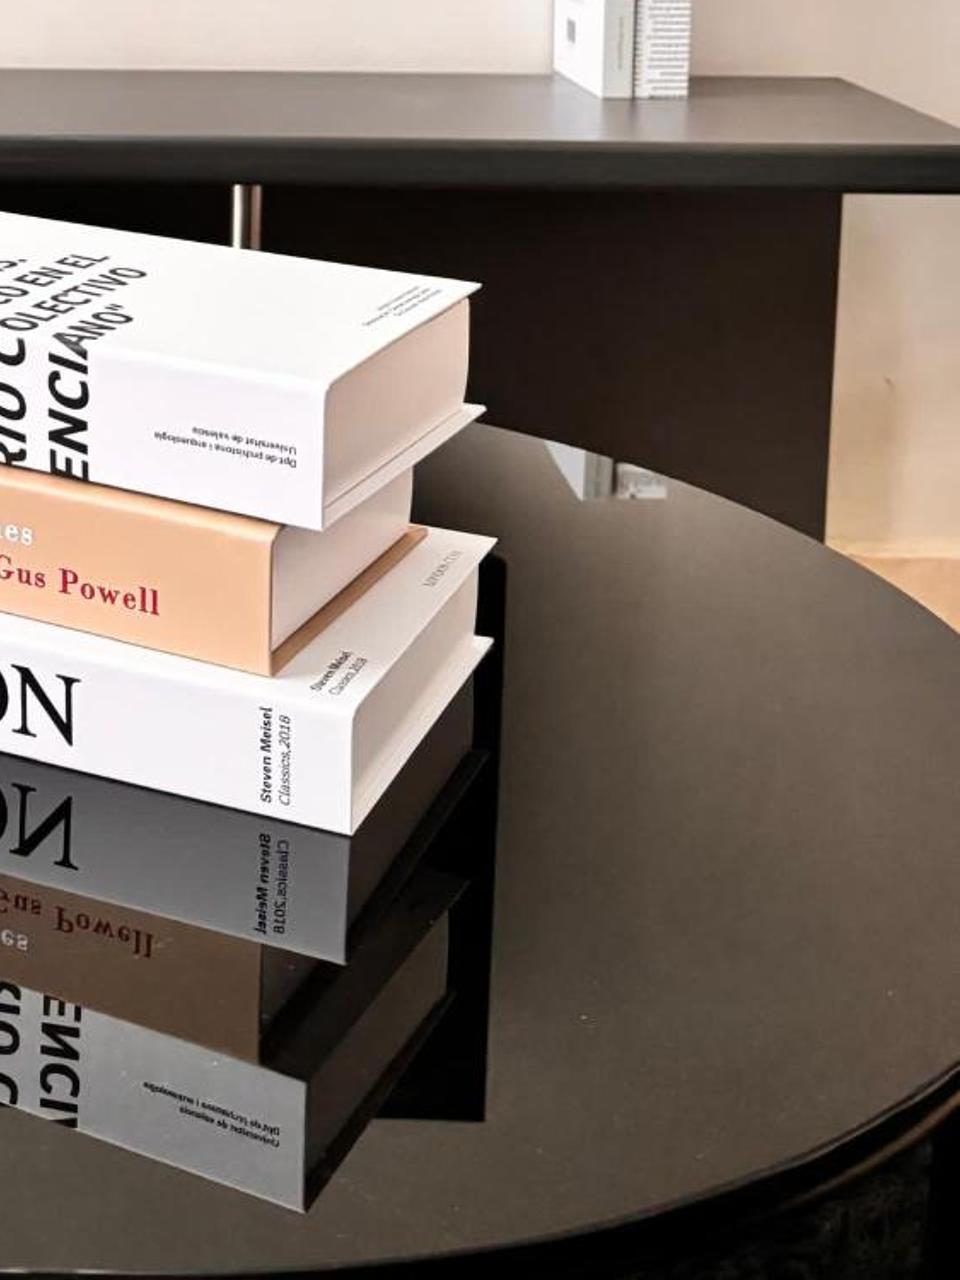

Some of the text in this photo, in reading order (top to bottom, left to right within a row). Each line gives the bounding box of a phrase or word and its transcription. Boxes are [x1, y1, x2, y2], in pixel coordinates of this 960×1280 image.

[16, 266, 67, 287] EN
[55, 253, 110, 269] EL
[58, 568, 161, 616] Powell
[259, 706, 273, 804] Steven Meisel
